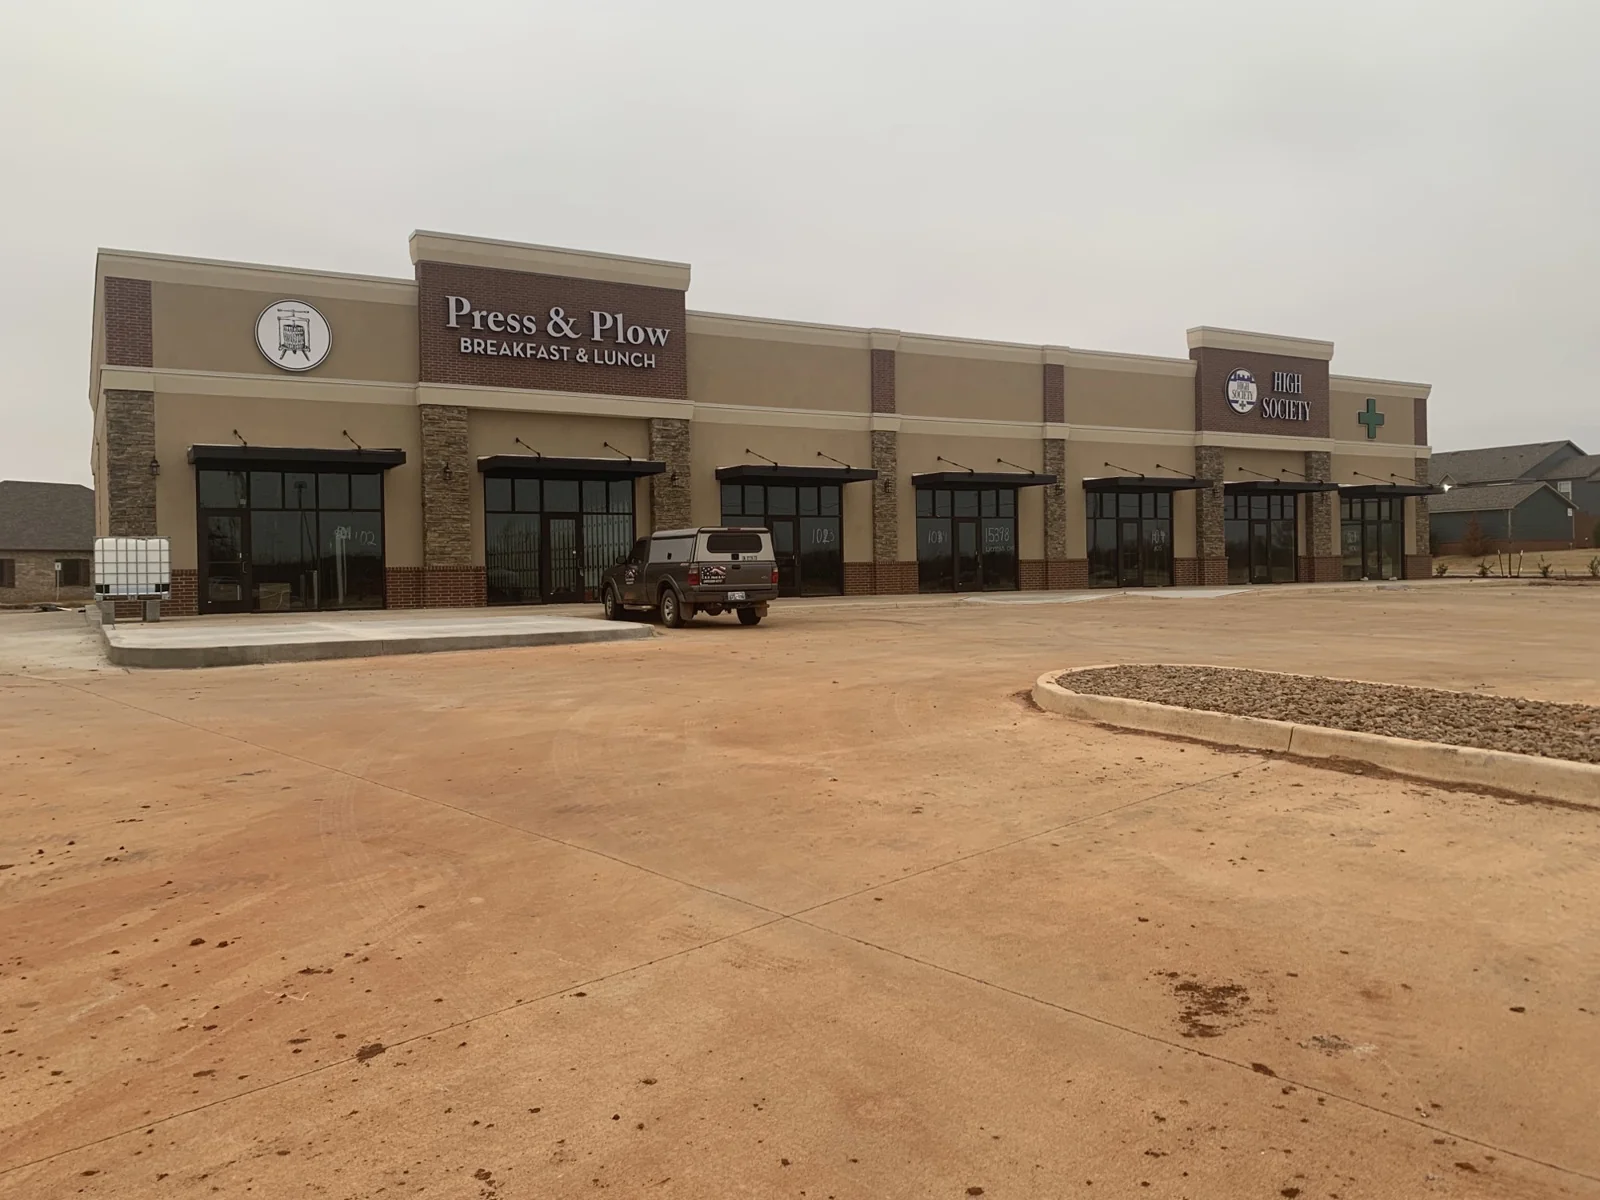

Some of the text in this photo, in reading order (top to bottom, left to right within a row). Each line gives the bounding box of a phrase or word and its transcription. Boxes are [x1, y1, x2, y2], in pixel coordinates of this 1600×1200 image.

[445, 295, 671, 347] Press & Plow
[460, 337, 656, 368] BREAKFAST & LUNCH
[1274, 371, 1302, 394] HIGH
[1232, 389, 1253, 401] SOCIETY
[1262, 397, 1312, 421] SOCIETY
